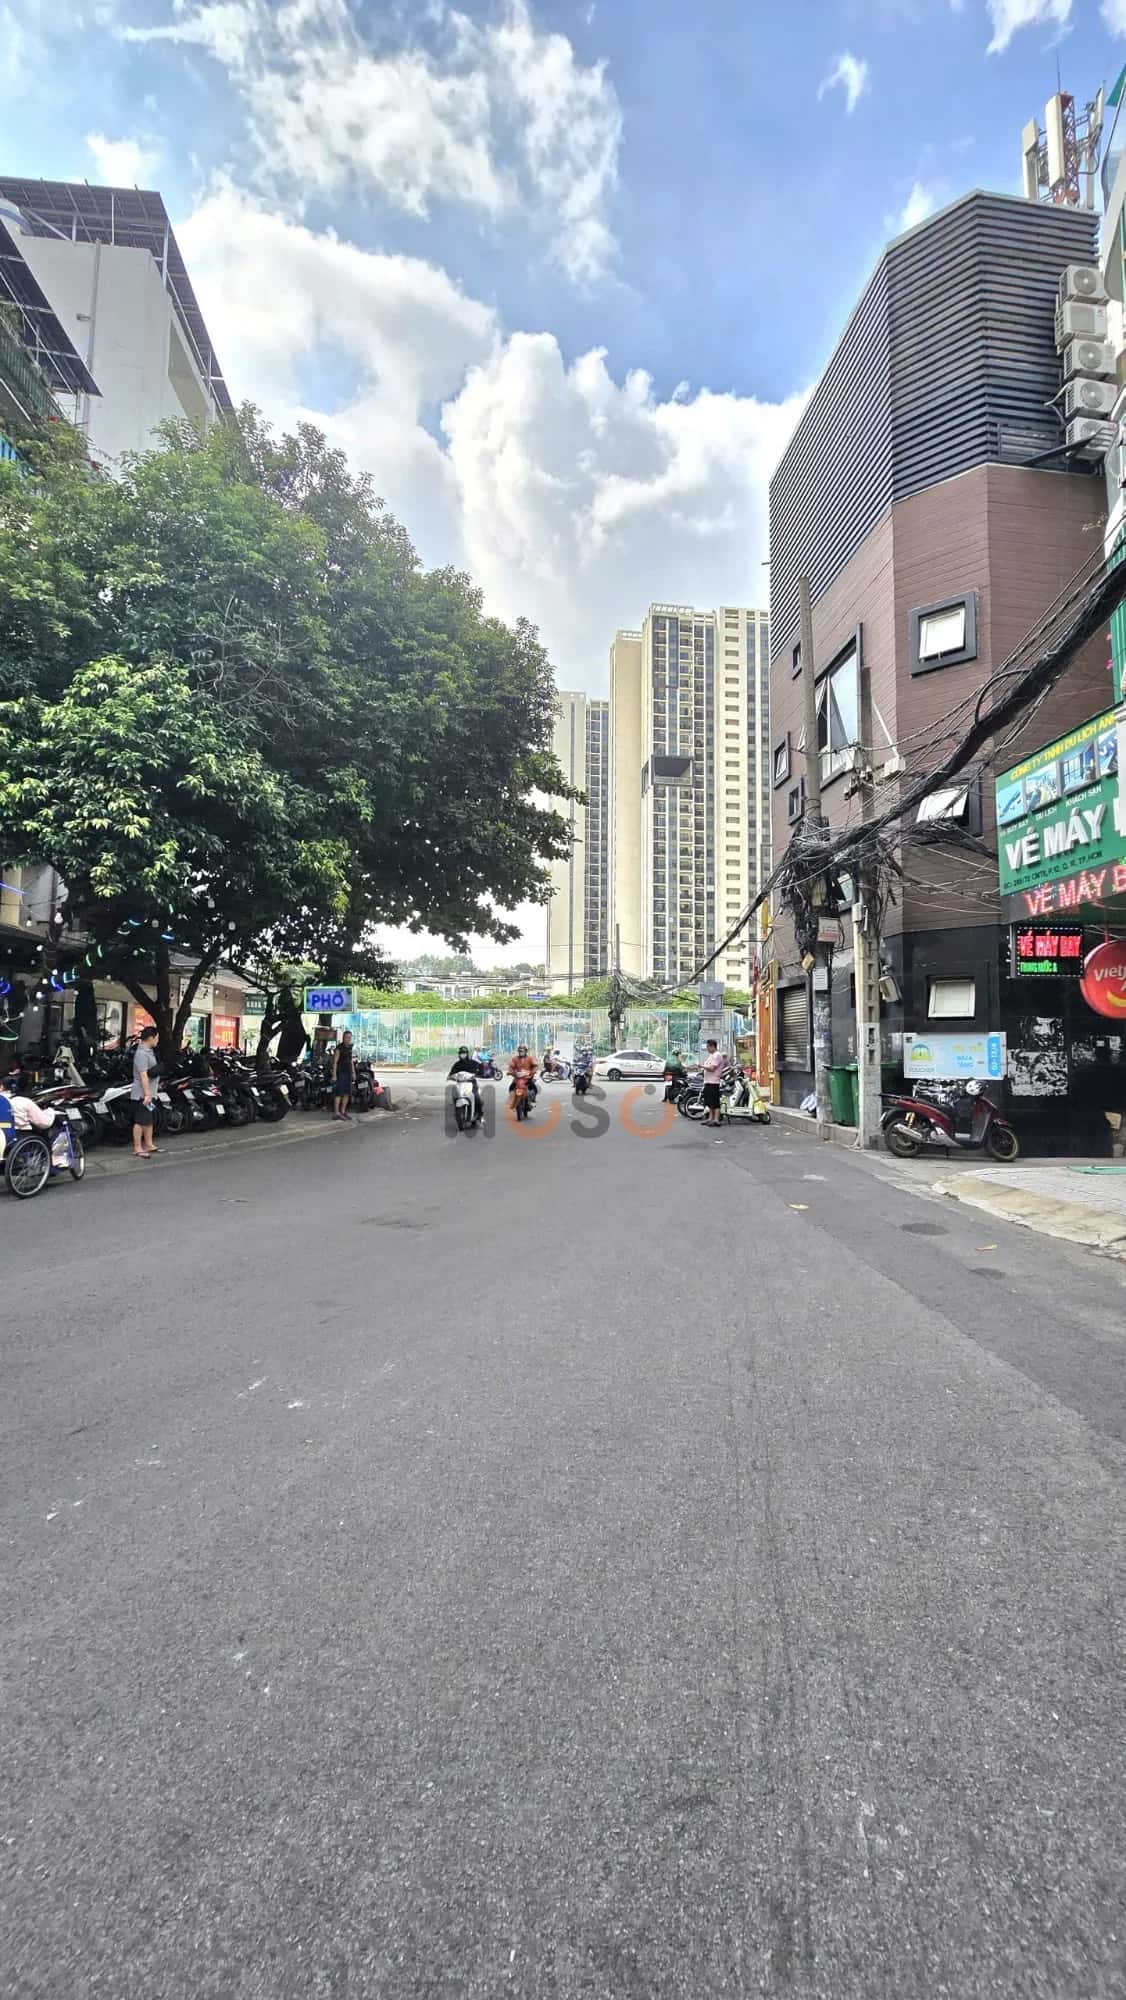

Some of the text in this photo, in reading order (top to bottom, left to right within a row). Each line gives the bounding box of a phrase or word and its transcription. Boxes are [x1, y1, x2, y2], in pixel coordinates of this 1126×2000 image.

[1005, 826, 1041, 870] VÉ
[1043, 804, 1106, 858] MÁY
[1024, 882, 1053, 915] VÉ
[1058, 870, 1107, 908] MÁY
[1018, 930, 1081, 957] VÉ MÁY BAY
